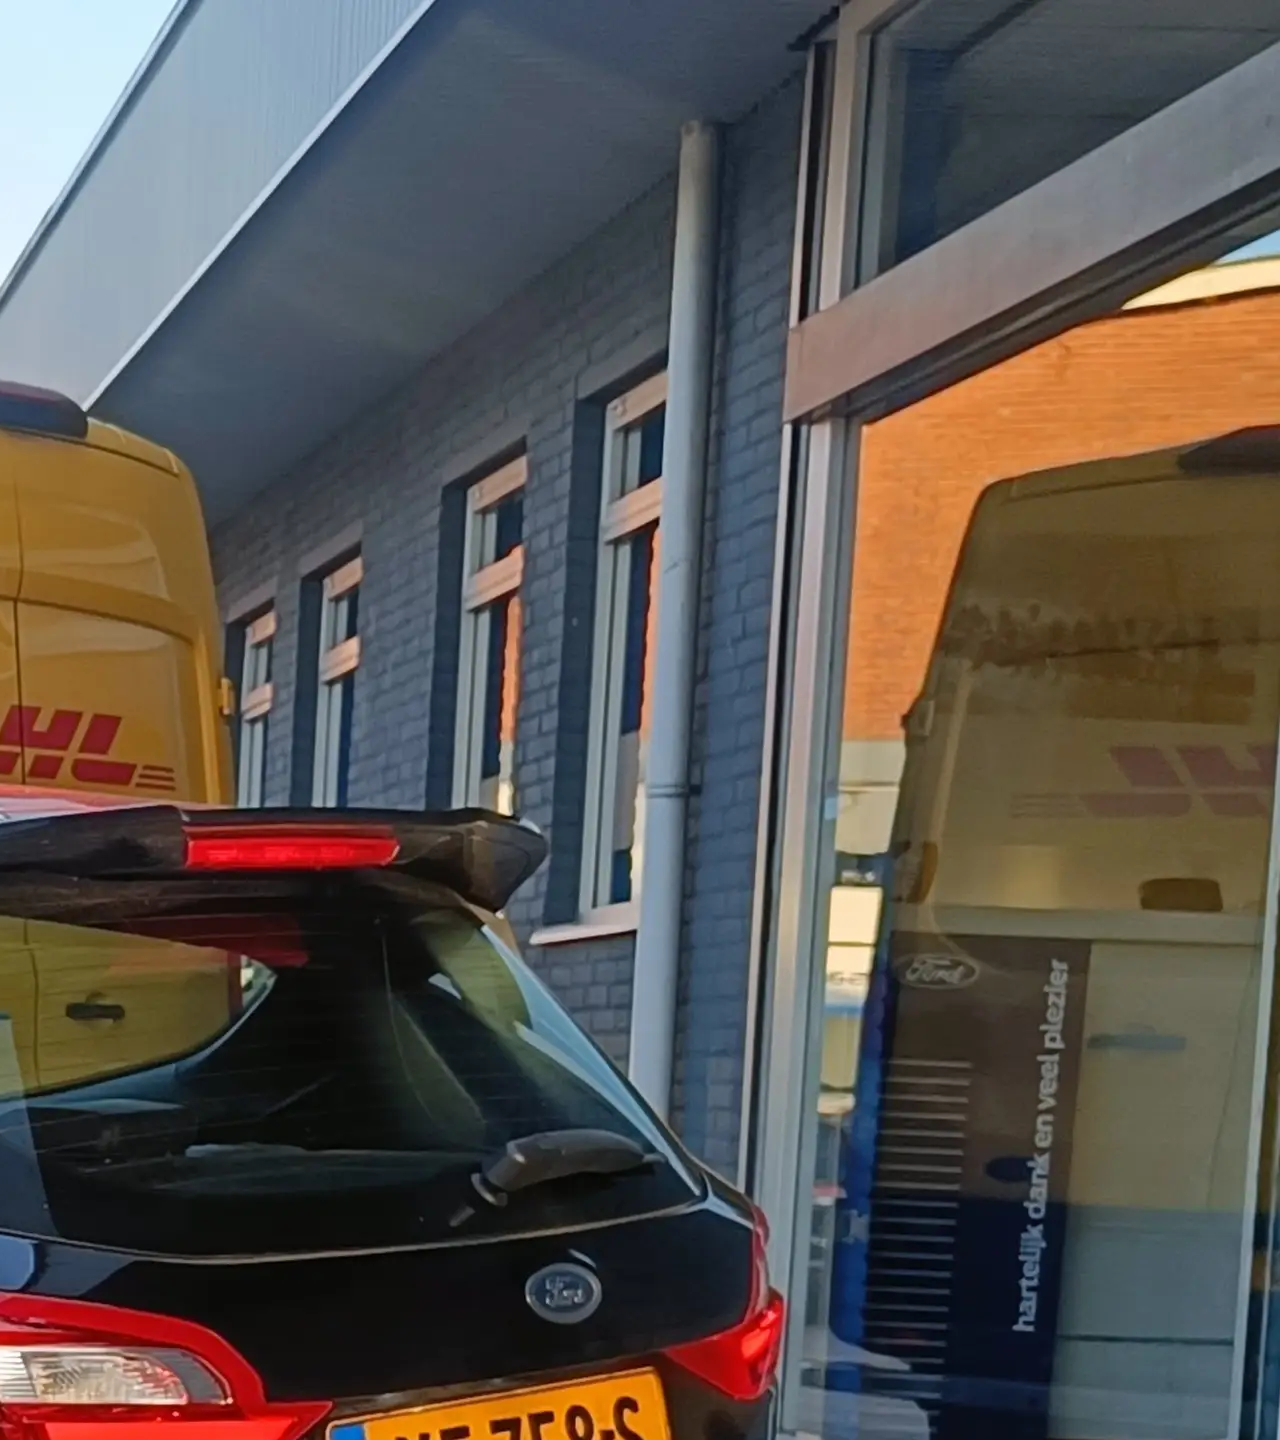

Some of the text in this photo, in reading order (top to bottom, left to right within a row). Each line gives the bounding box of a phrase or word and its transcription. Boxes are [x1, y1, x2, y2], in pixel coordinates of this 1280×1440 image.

[1012, 958, 1068, 1333] hartelijk dank en veel plezier
